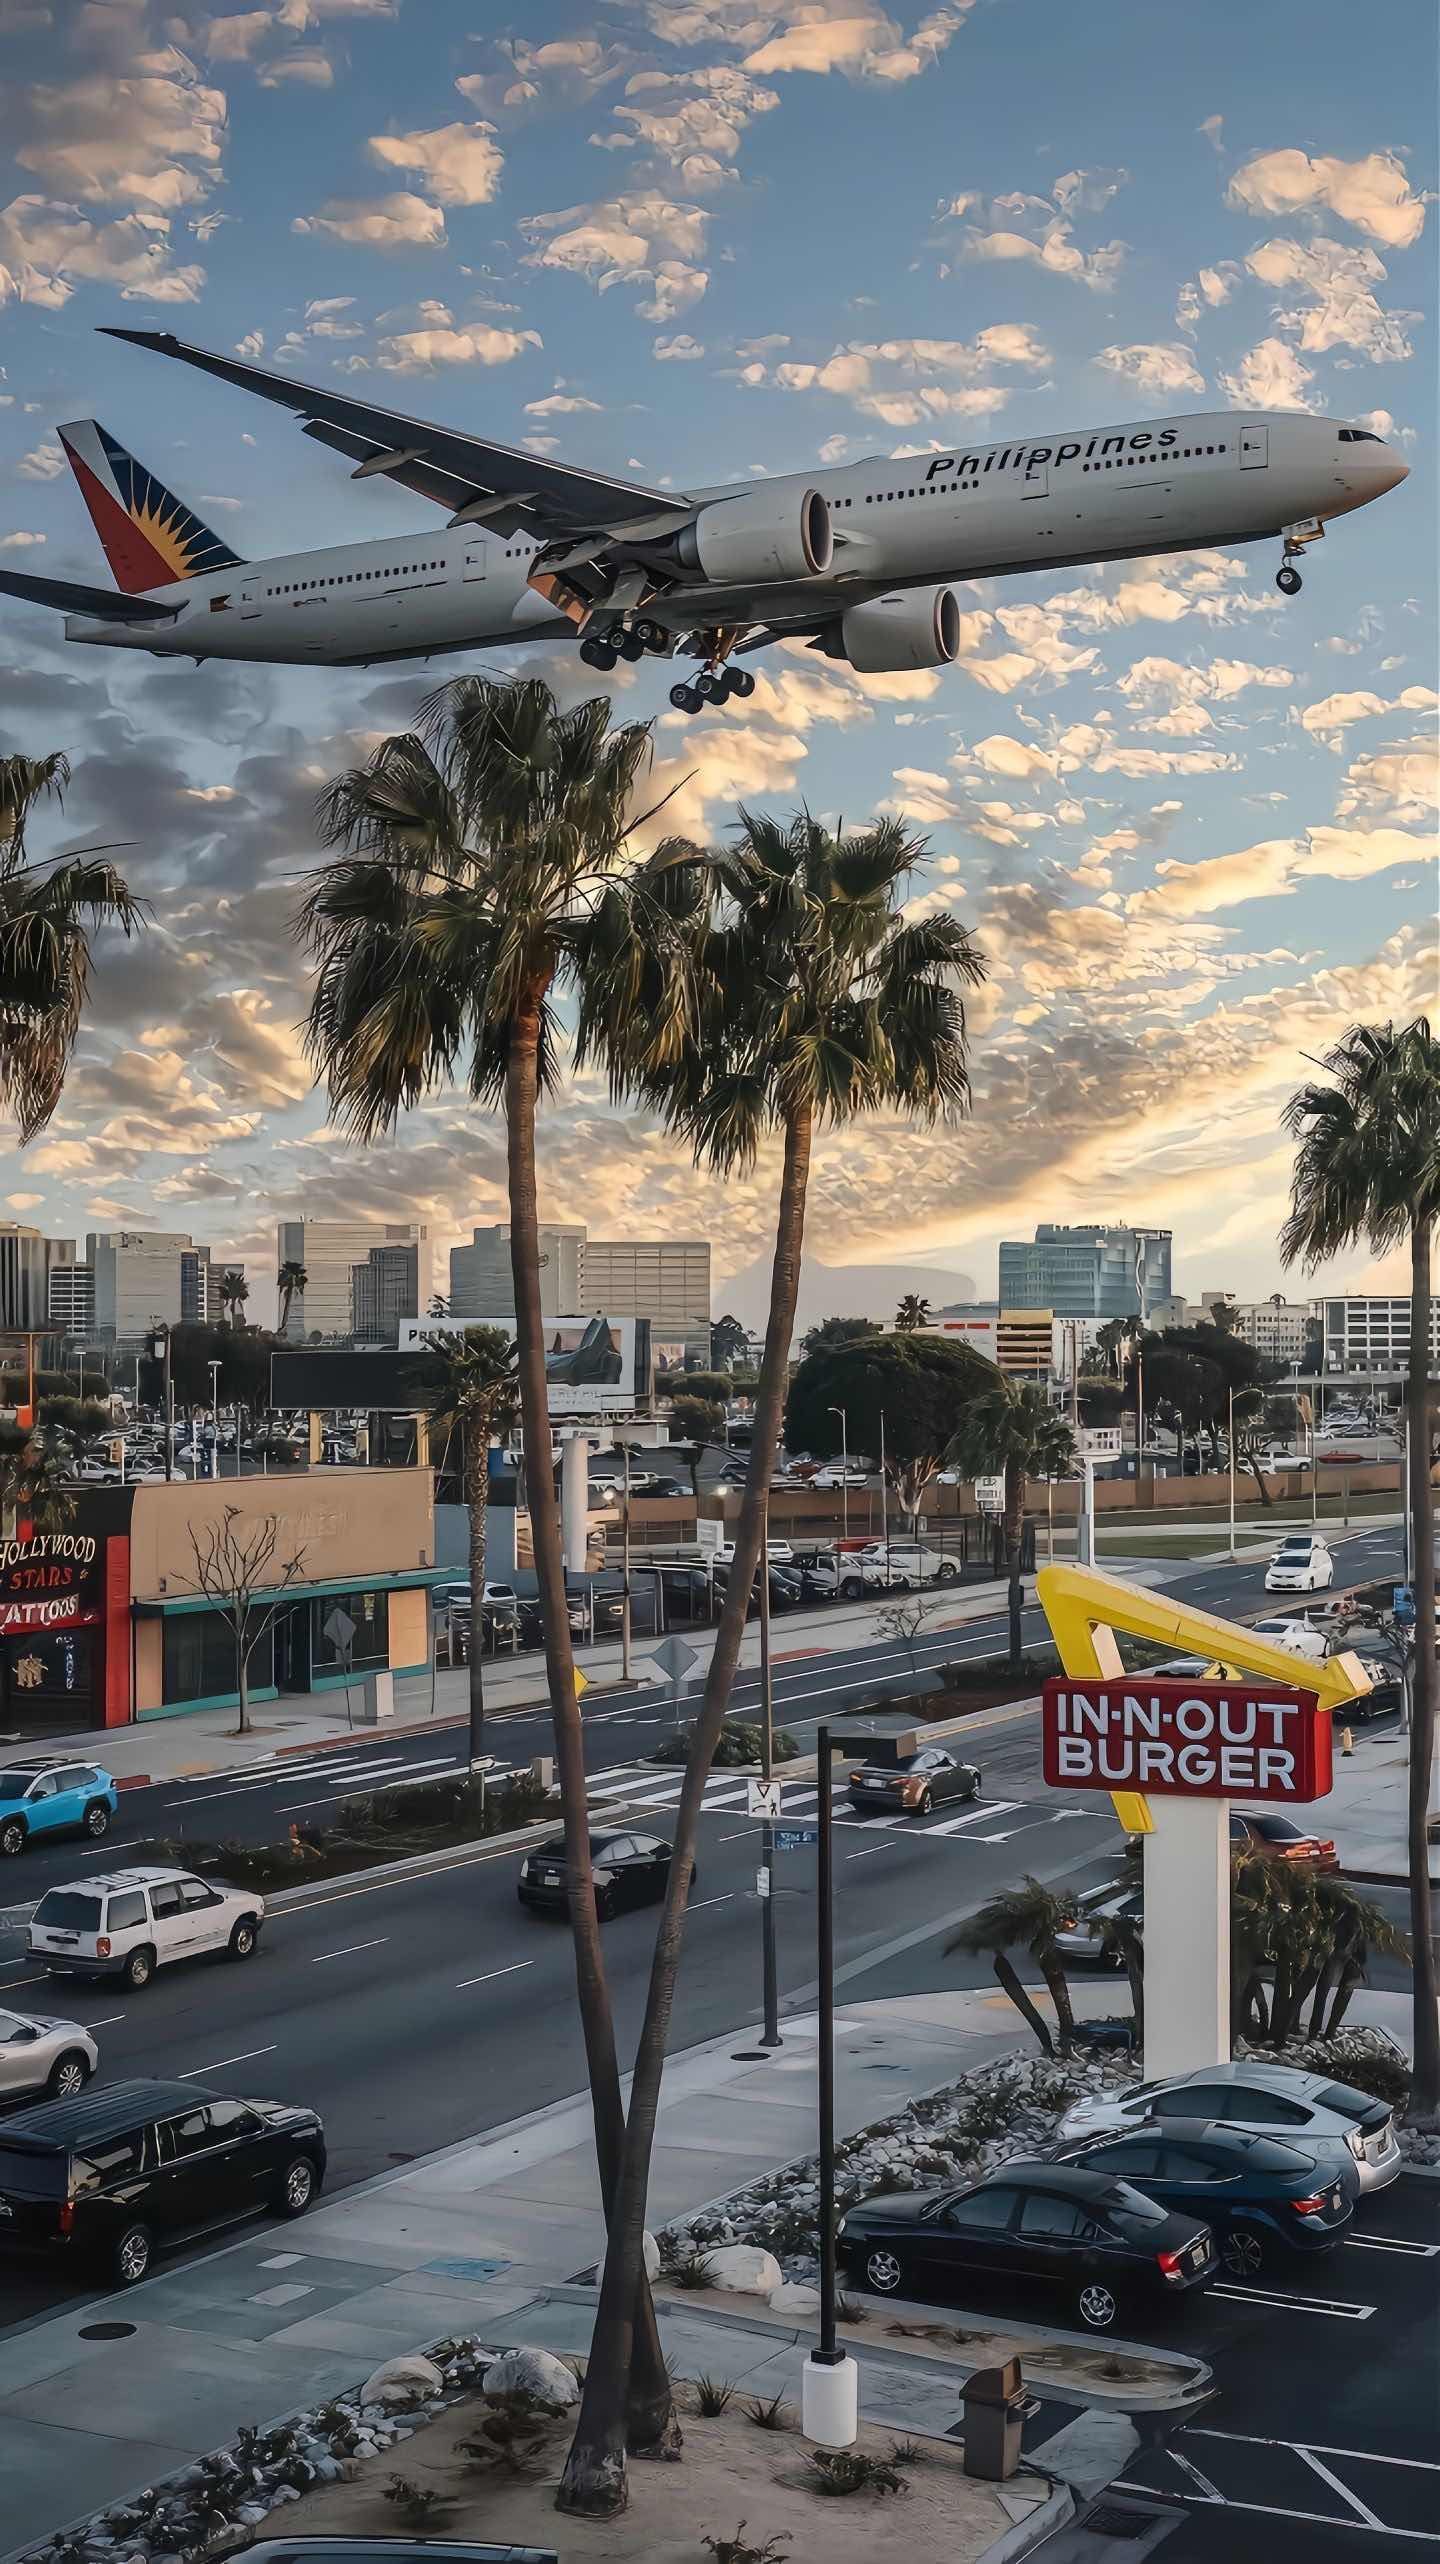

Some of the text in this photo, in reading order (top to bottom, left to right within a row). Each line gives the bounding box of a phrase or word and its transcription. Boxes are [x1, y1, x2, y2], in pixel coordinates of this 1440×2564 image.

[926, 429, 1178, 480] Philippines
[9, 1566, 73, 1590] STARS
[1058, 1736, 1296, 1790] BURGER
